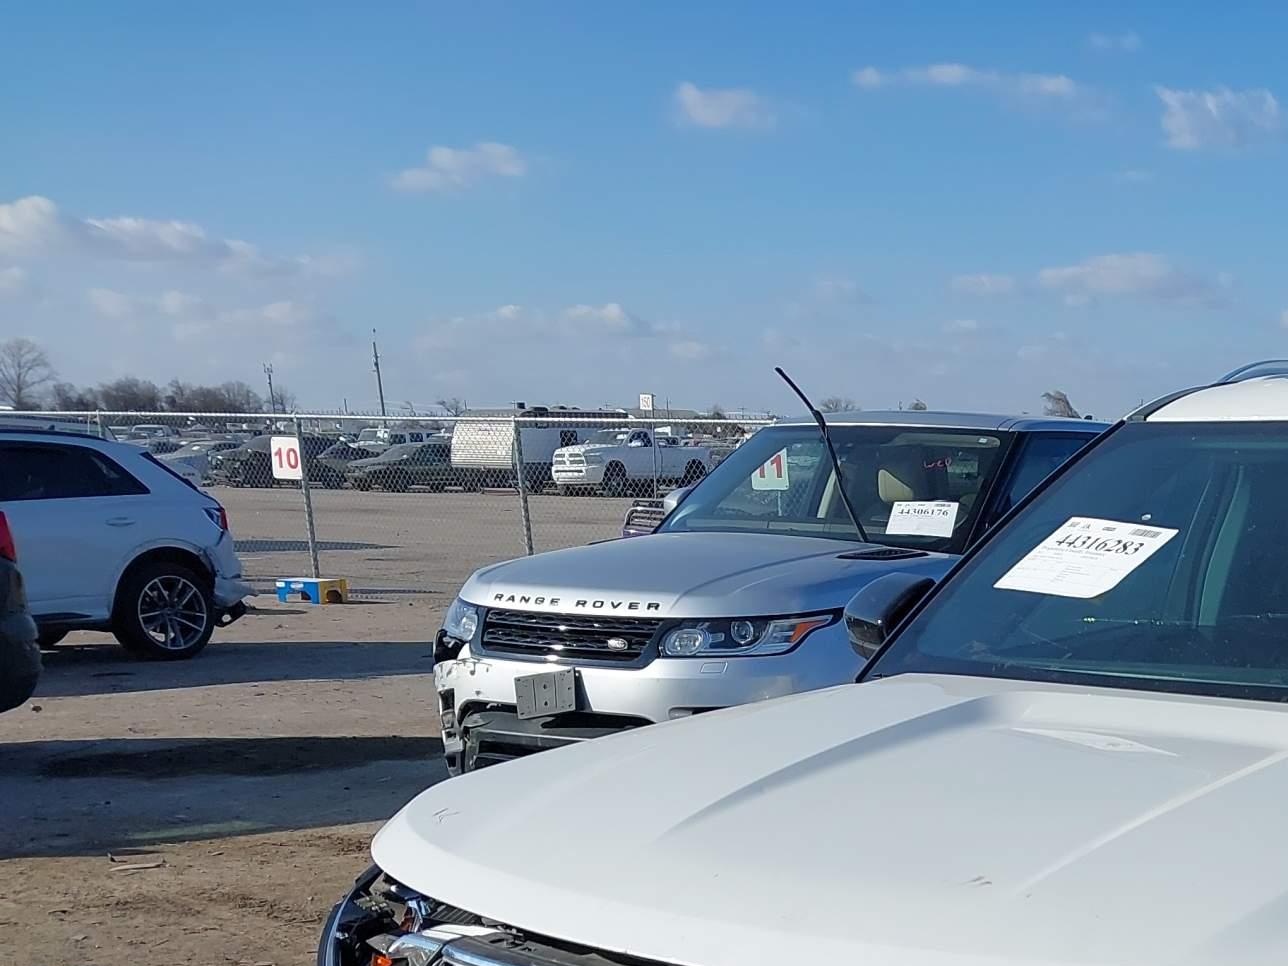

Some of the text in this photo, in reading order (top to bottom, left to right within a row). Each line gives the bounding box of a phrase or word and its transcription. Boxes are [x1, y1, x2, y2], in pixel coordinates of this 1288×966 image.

[274, 447, 299, 470] 10
[897, 508, 949, 517] 44306176
[1055, 533, 1145, 556] 44316283
[494, 593, 660, 611] RANGE ROVER
